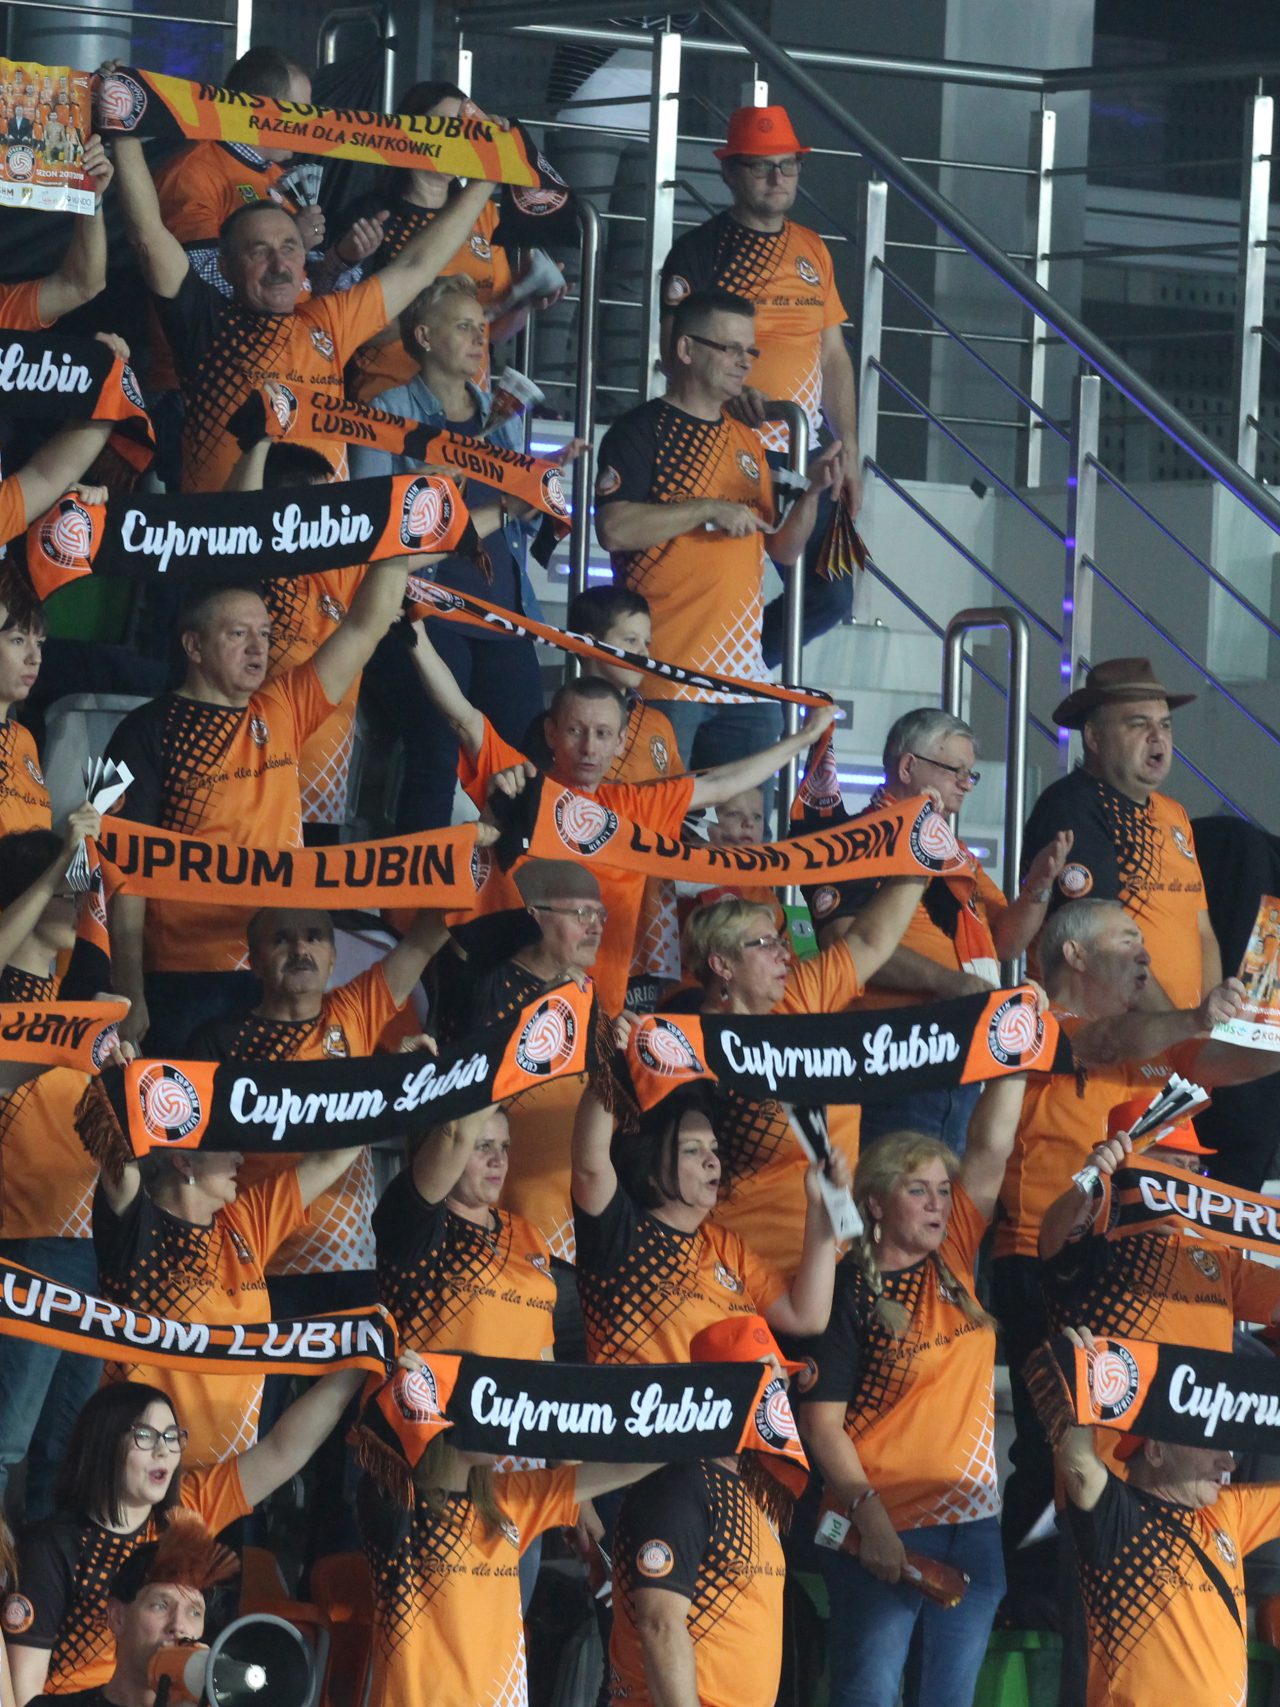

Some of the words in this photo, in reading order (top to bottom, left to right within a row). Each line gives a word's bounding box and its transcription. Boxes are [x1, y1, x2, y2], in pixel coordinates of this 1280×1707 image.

[249, 115, 308, 136] RAZEM
[312, 125, 346, 144] DLA
[409, 113, 494, 143] LUBIN
[310, 392, 405, 428] CUPRUM
[312, 417, 376, 441] LUBIN
[442, 445, 504, 483] LUBIN
[121, 509, 263, 572] Cuprum
[272, 503, 373, 553] Lubin
[234, 764, 252, 779] dla
[96, 832, 293, 888] UPRUM
[315, 844, 455, 888] LUBIN
[794, 816, 904, 869] LUBIN
[721, 1030, 855, 1091] Cuprum
[863, 1023, 959, 1075] Lubin
[1141, 1063, 1169, 1079] plu
[173, 1072, 198, 1109] CUPRUM
[230, 1078, 386, 1140] Cuprum
[394, 1054, 489, 1112] Lubin
[179, 1113, 199, 1136] LUBIN
[501, 1289, 522, 1305] dla
[228, 1319, 387, 1360] LUBIN
[471, 1377, 617, 1446] Cuprum
[624, 1383, 733, 1437] Lubin
[1169, 1364, 1280, 1437] Cupru
[472, 1562, 491, 1578] dla
